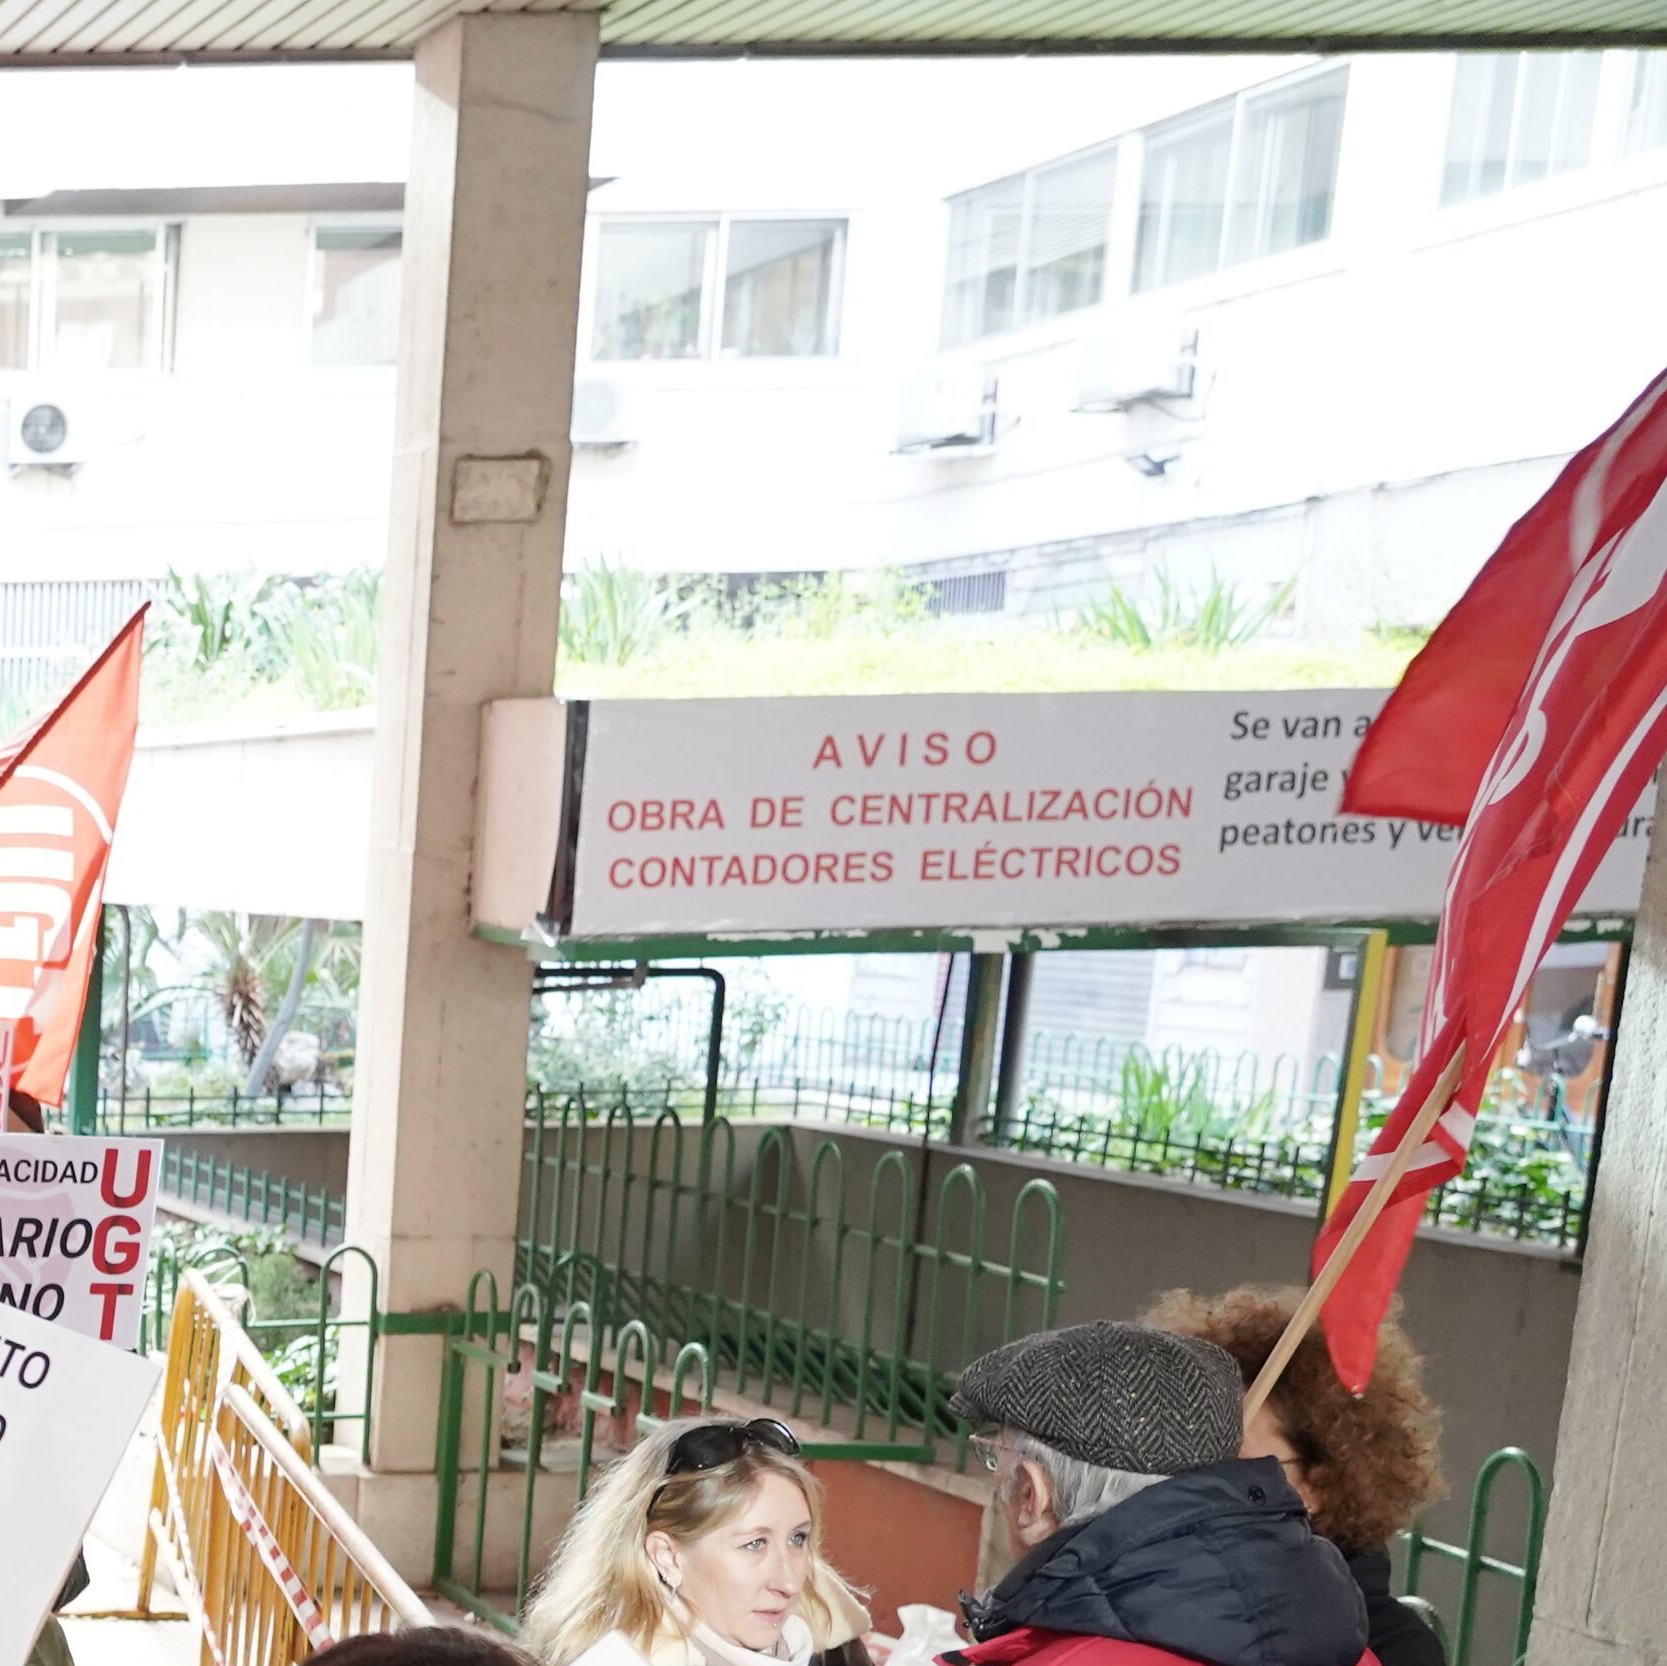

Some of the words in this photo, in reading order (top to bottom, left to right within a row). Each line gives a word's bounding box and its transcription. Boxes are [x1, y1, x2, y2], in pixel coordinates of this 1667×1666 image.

[1230, 711, 1269, 739] Se
[1282, 714, 1341, 738] van
[814, 730, 999, 772] AVISO
[1224, 763, 1328, 800] garaje
[608, 798, 725, 835] OBRA
[750, 793, 803, 828] DE
[831, 781, 1193, 828] CENTRALIZACIÓN
[1220, 819, 1375, 853] peatones
[1387, 821, 1406, 848] y
[608, 850, 895, 889] CONTADORES
[920, 837, 1181, 882] ELÉCTRICOS
[90, 1148, 152, 1341] UGT
